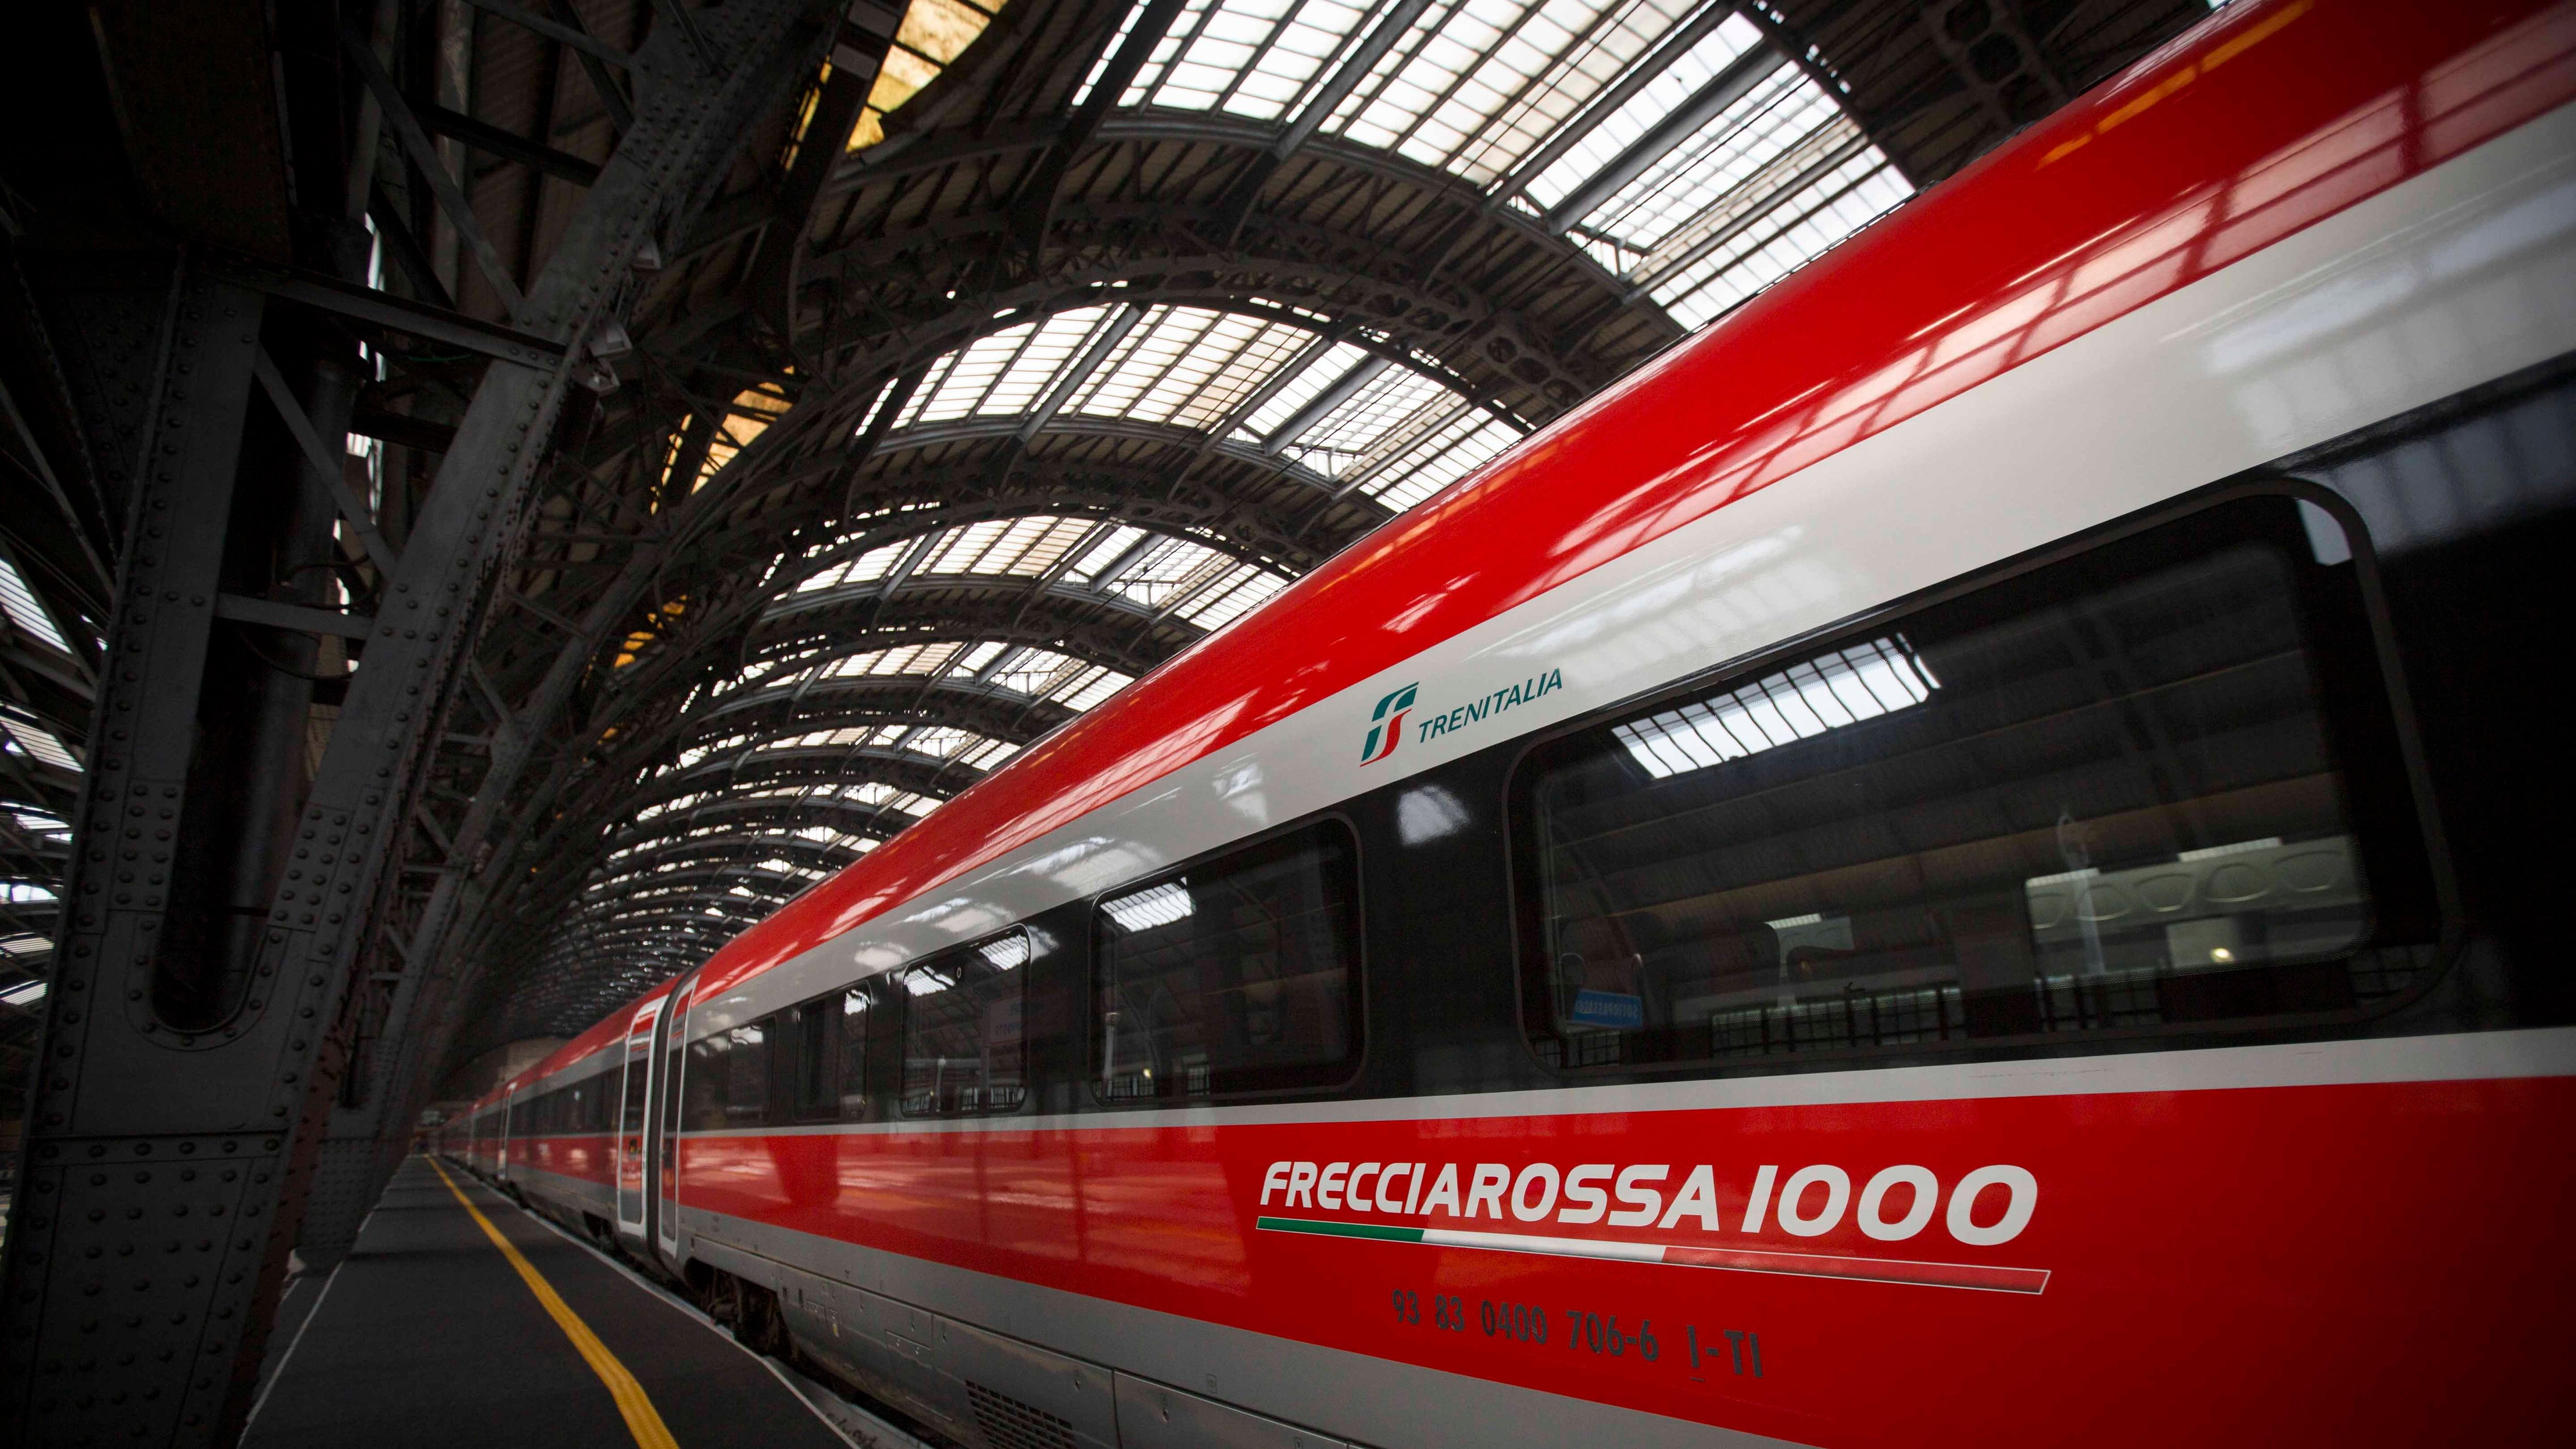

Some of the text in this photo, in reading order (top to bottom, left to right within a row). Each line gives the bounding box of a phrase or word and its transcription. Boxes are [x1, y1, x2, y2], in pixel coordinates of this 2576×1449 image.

[1419, 668, 1562, 743] TRENITALIA
[1261, 1161, 2038, 1246] FRECCIAROSSA 1000
[1392, 1289, 1420, 1325] 93
[1435, 1293, 1465, 1332] 83
[1481, 1300, 1548, 1344] 0400
[1566, 1310, 1659, 1361] 706-6
